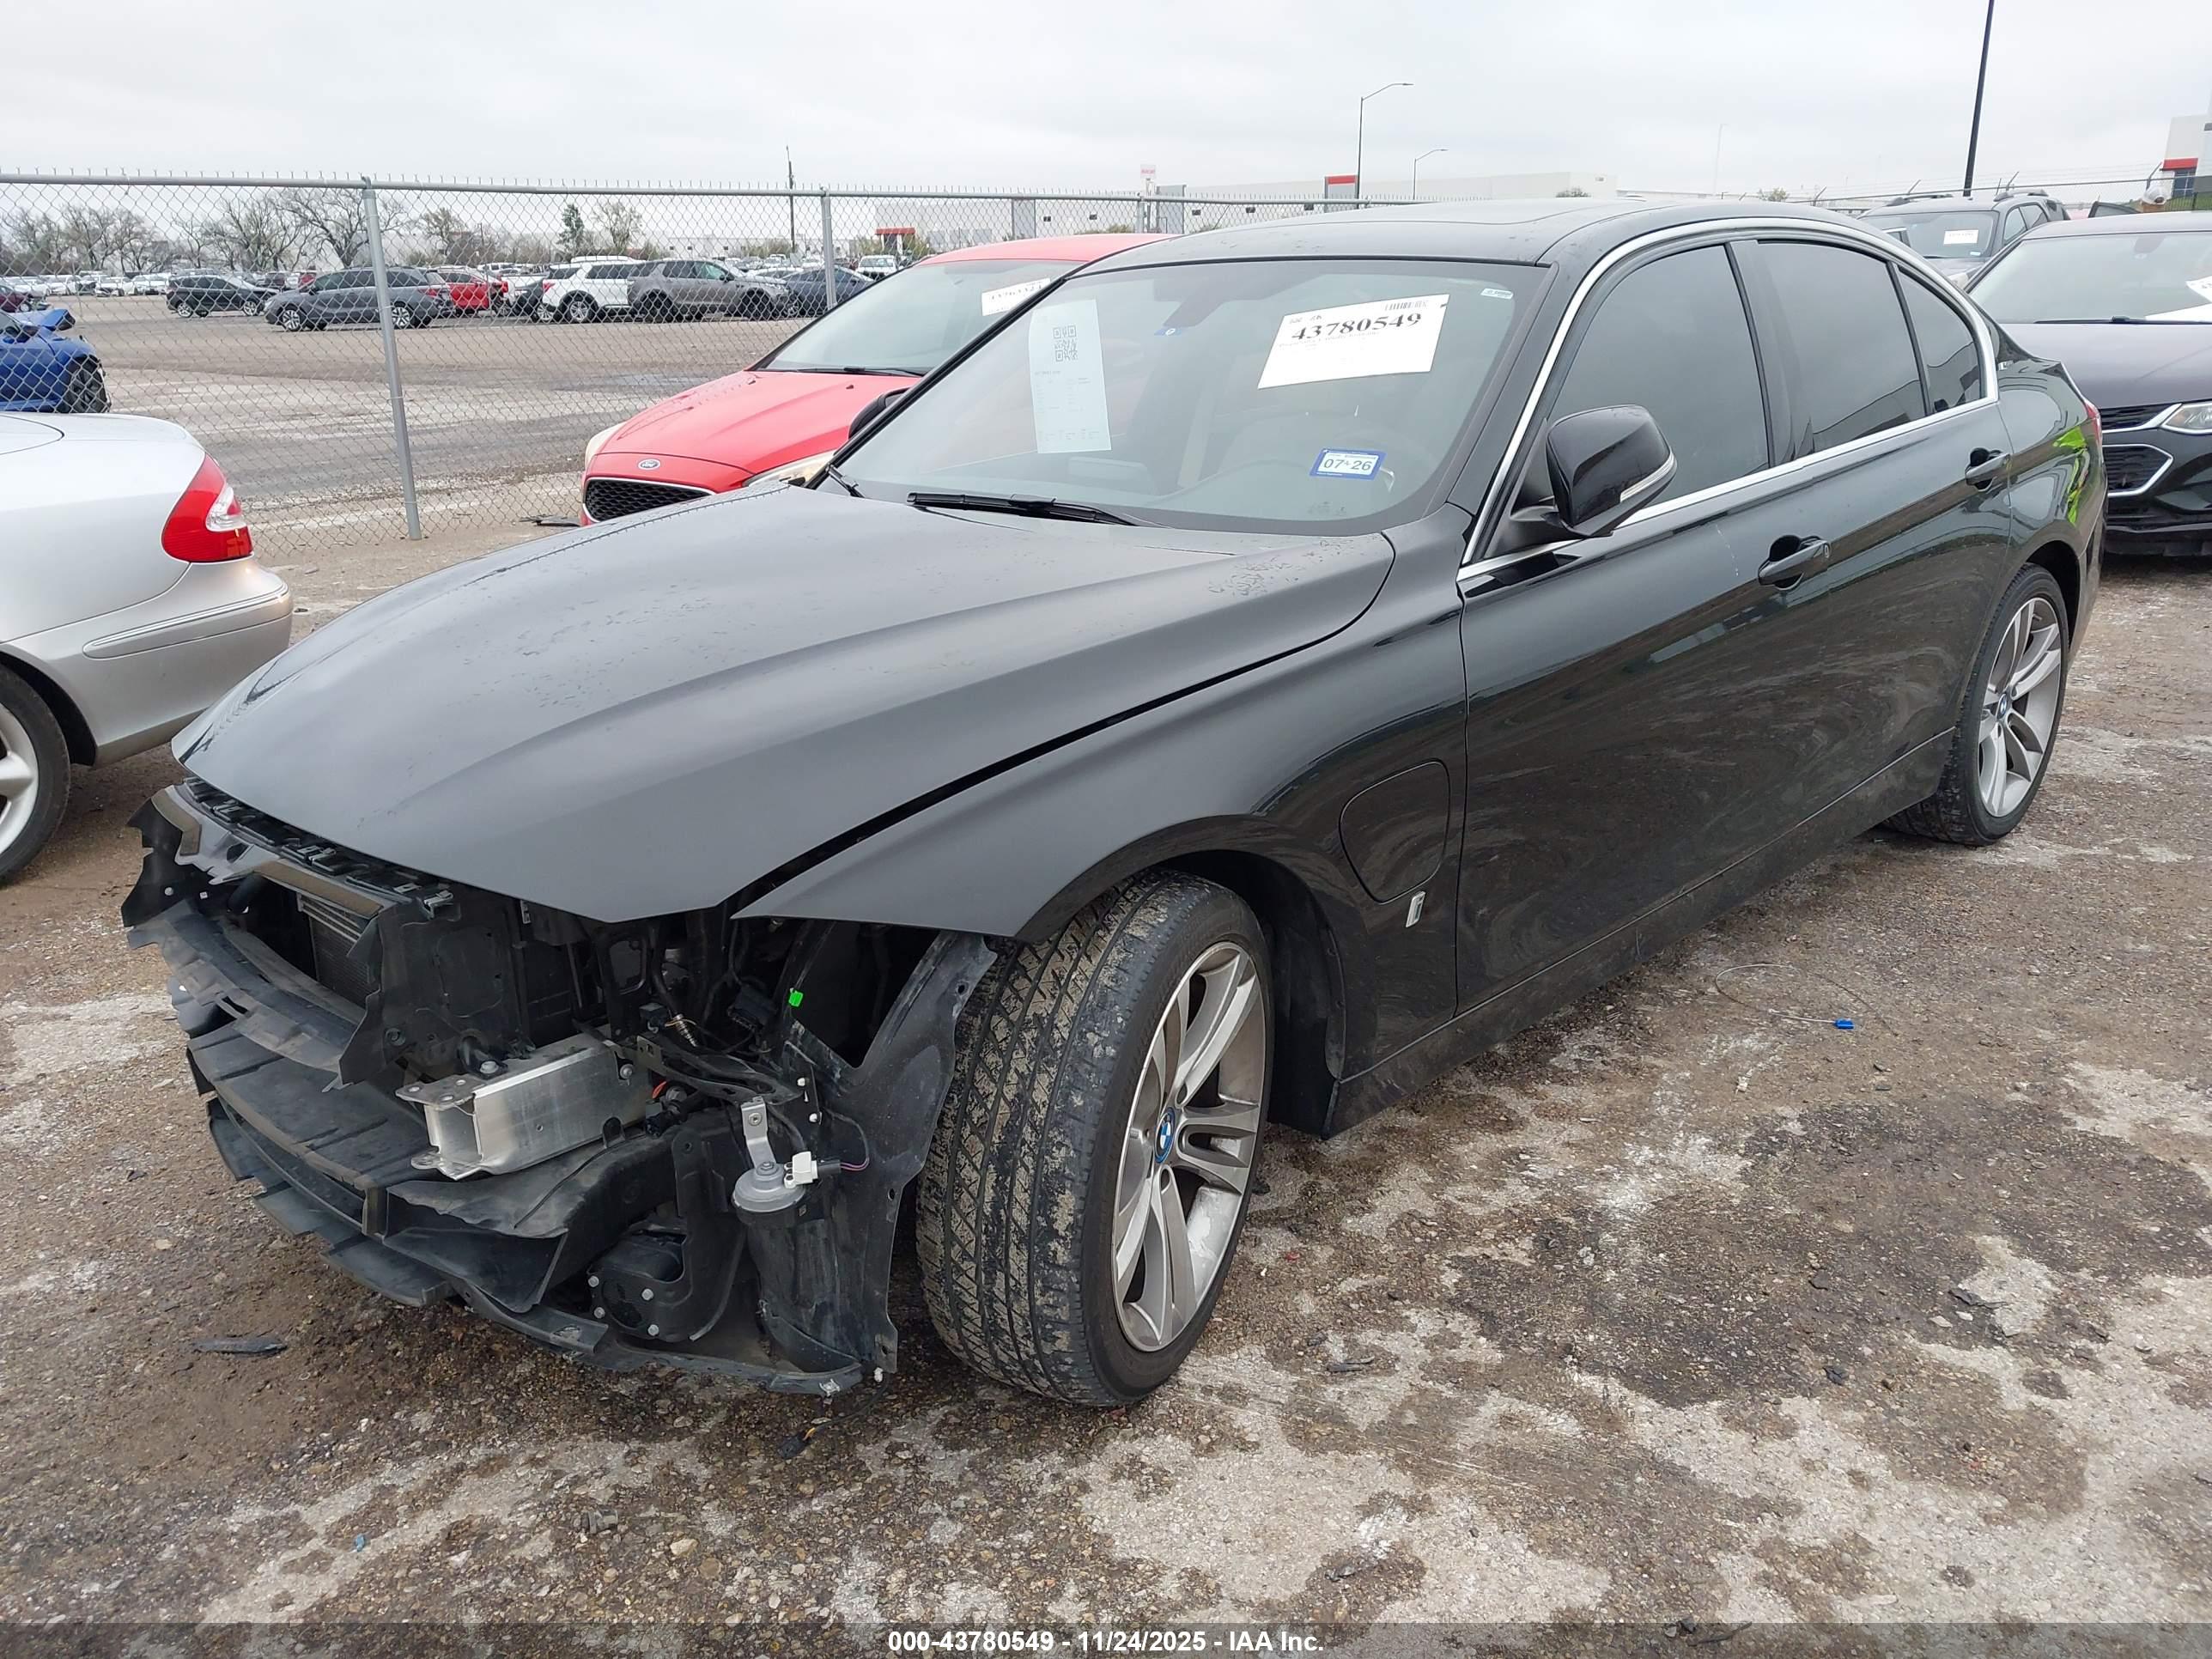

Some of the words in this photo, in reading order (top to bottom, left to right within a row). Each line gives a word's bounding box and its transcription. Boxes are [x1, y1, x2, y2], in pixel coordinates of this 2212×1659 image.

[1291, 313, 1422, 341] 43780549
[1323, 458, 1345, 470] 07
[1350, 459, 1373, 471] 26
